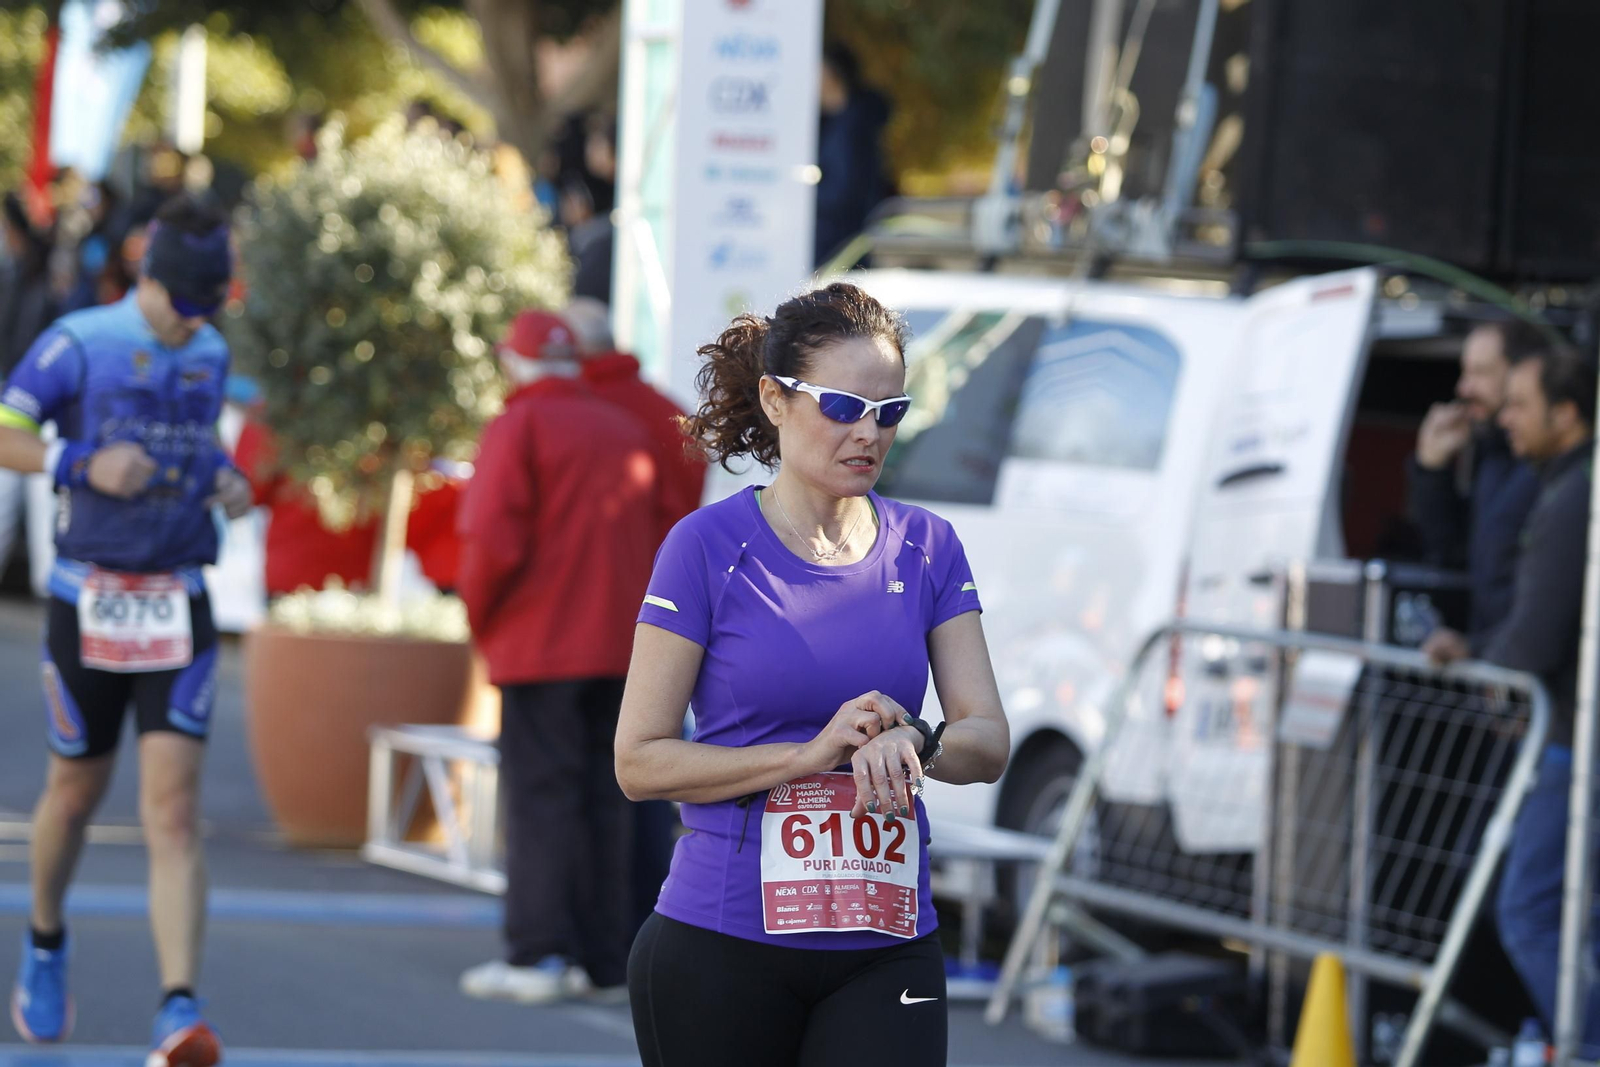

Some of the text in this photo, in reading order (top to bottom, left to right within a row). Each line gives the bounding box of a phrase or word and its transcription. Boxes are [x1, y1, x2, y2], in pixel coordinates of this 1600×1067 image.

[796, 782, 821, 790] MEDIO
[796, 788, 835, 797] MARATÓN
[797, 796, 832, 805] ALMERÍA
[781, 813, 906, 864] 6102
[803, 859, 892, 875] PURI AGUADO
[775, 887, 797, 896] NEXA
[802, 884, 819, 894] CDX
